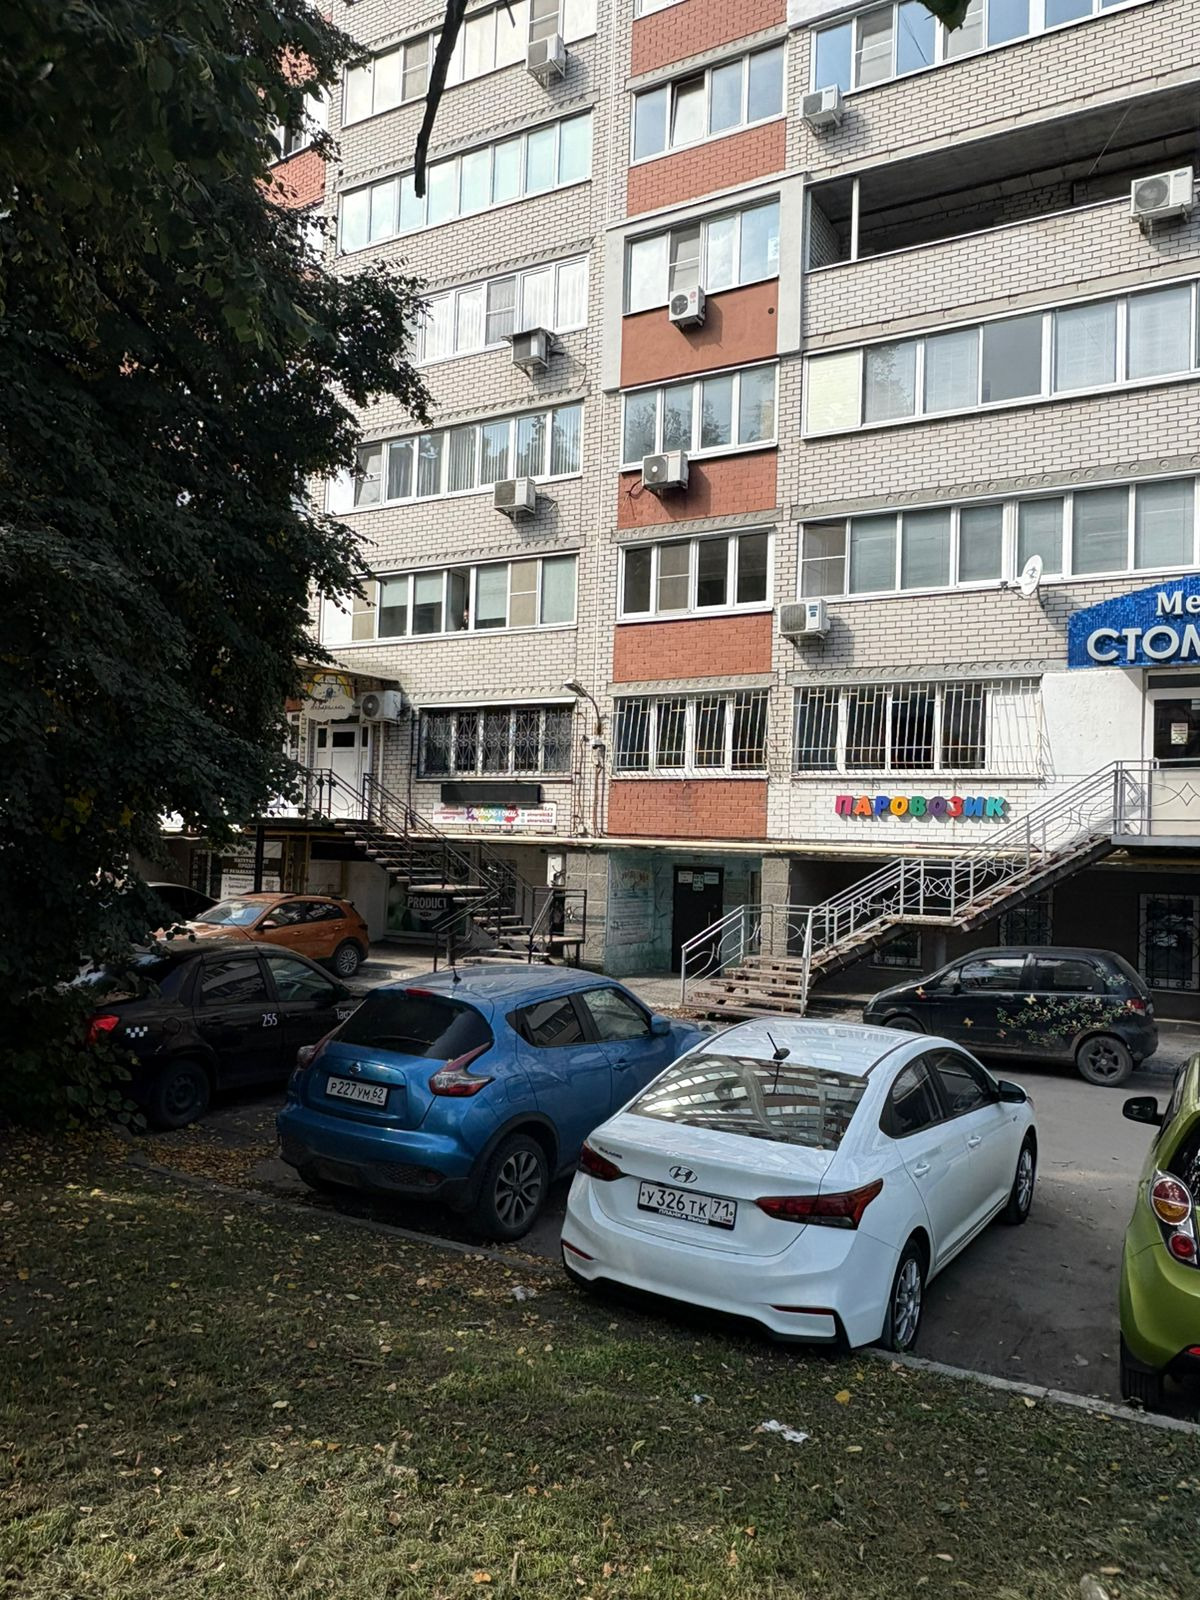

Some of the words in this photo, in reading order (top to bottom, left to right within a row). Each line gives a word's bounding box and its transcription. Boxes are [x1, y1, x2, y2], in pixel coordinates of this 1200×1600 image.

[835, 795, 1006, 817] ПАРОВОЗИК
[407, 896, 448, 909] PRODUCT
[262, 1013, 278, 1027] 255
